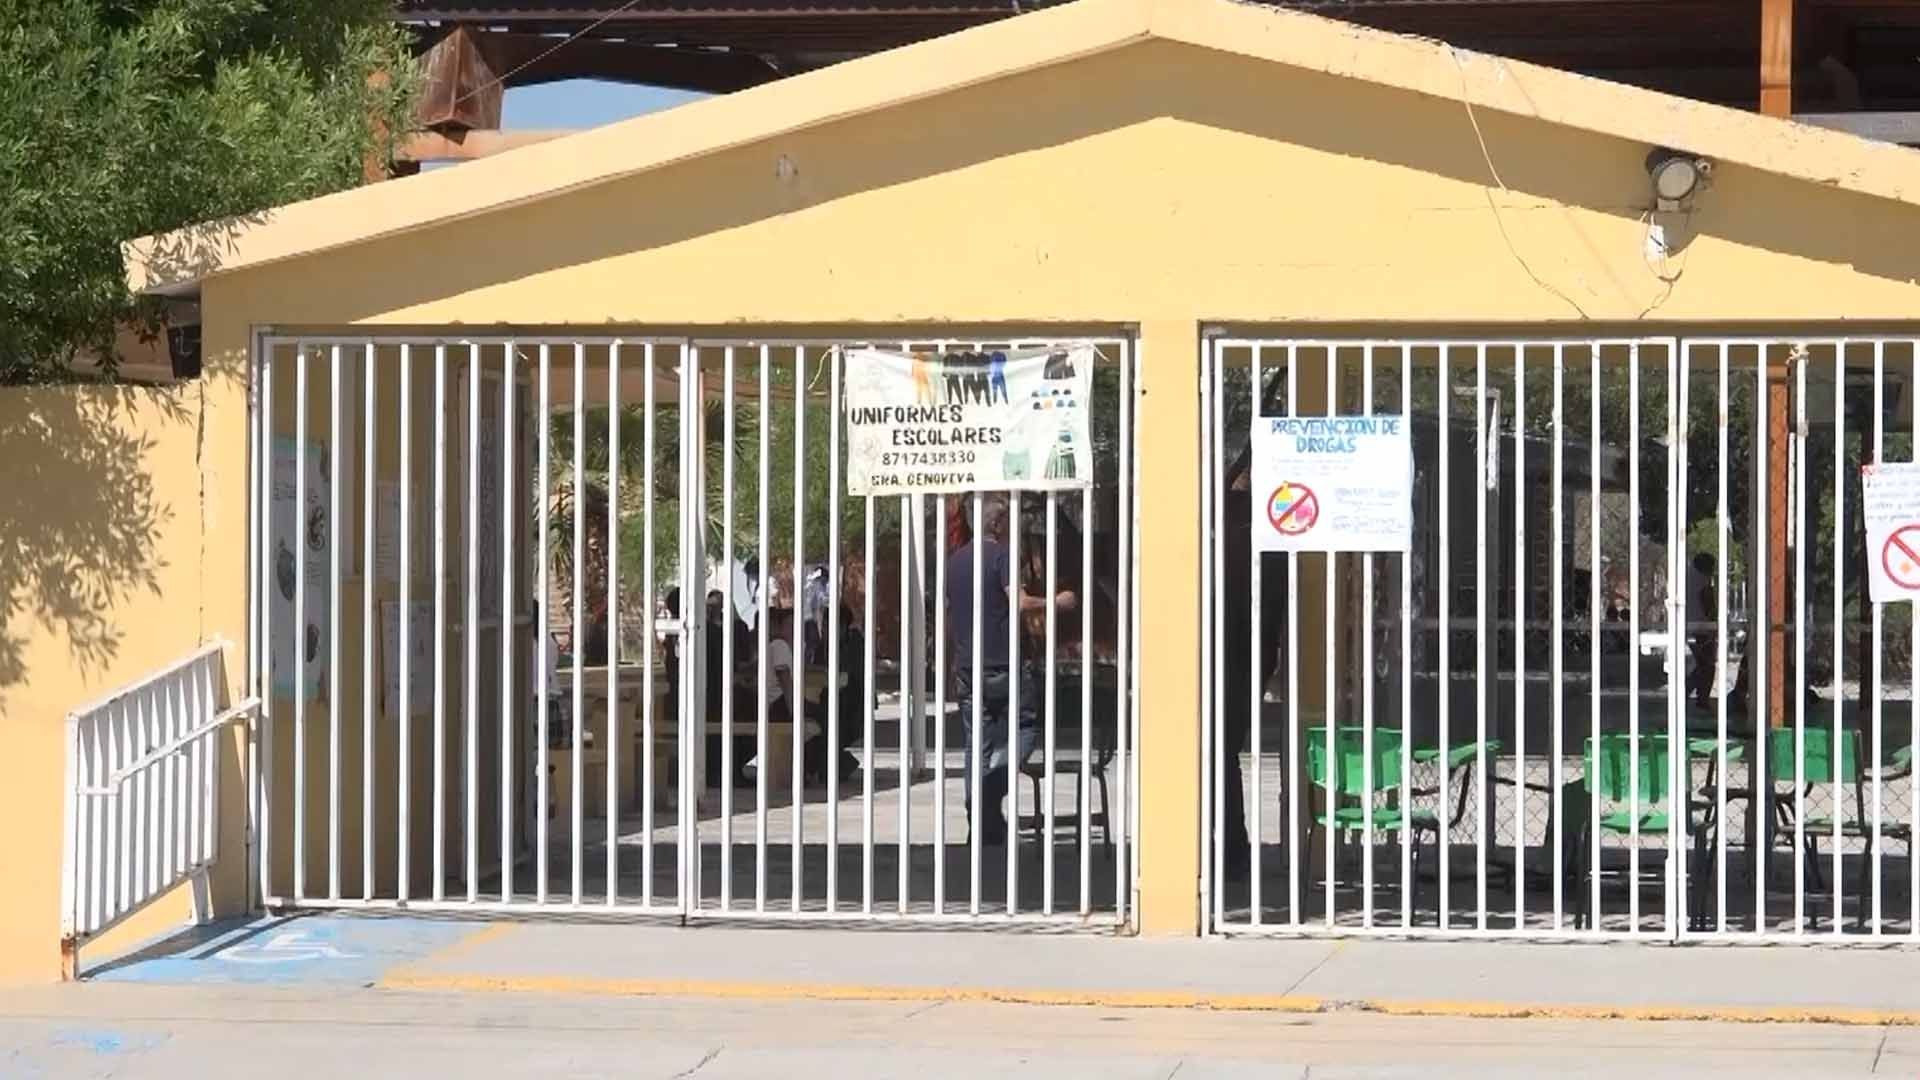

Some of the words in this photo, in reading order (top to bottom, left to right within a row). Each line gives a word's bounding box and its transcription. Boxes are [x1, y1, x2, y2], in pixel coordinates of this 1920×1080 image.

[851, 405, 963, 425] UNIFORMES
[1271, 419, 1377, 435] PREVENCION
[1381, 419, 1401, 435] DE
[892, 427, 1002, 446] ESCOLARES
[1295, 437, 1357, 453] DROGAS
[907, 472, 976, 487] GENOVEVA
